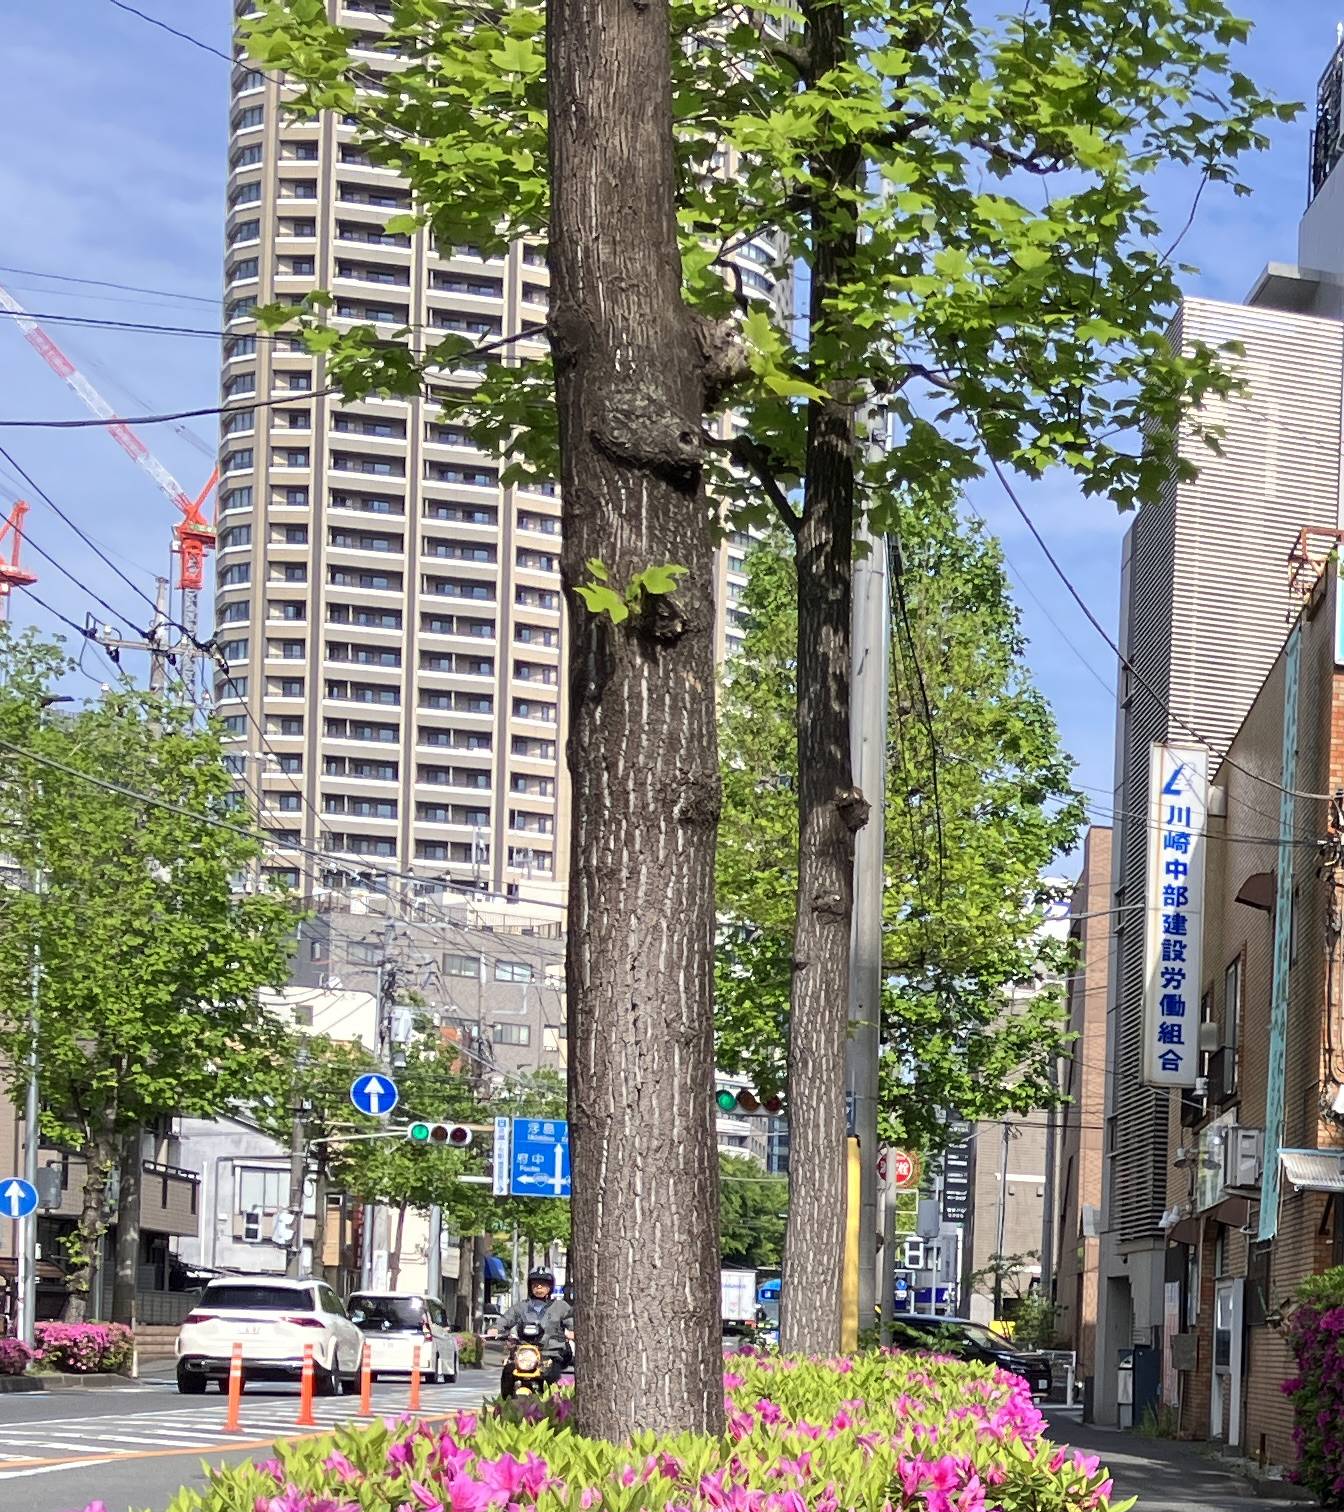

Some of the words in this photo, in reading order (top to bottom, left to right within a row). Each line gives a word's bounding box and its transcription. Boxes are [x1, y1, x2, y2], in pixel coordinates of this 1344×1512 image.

[1158, 805, 1191, 1073] 川崎中部建設労働組合
